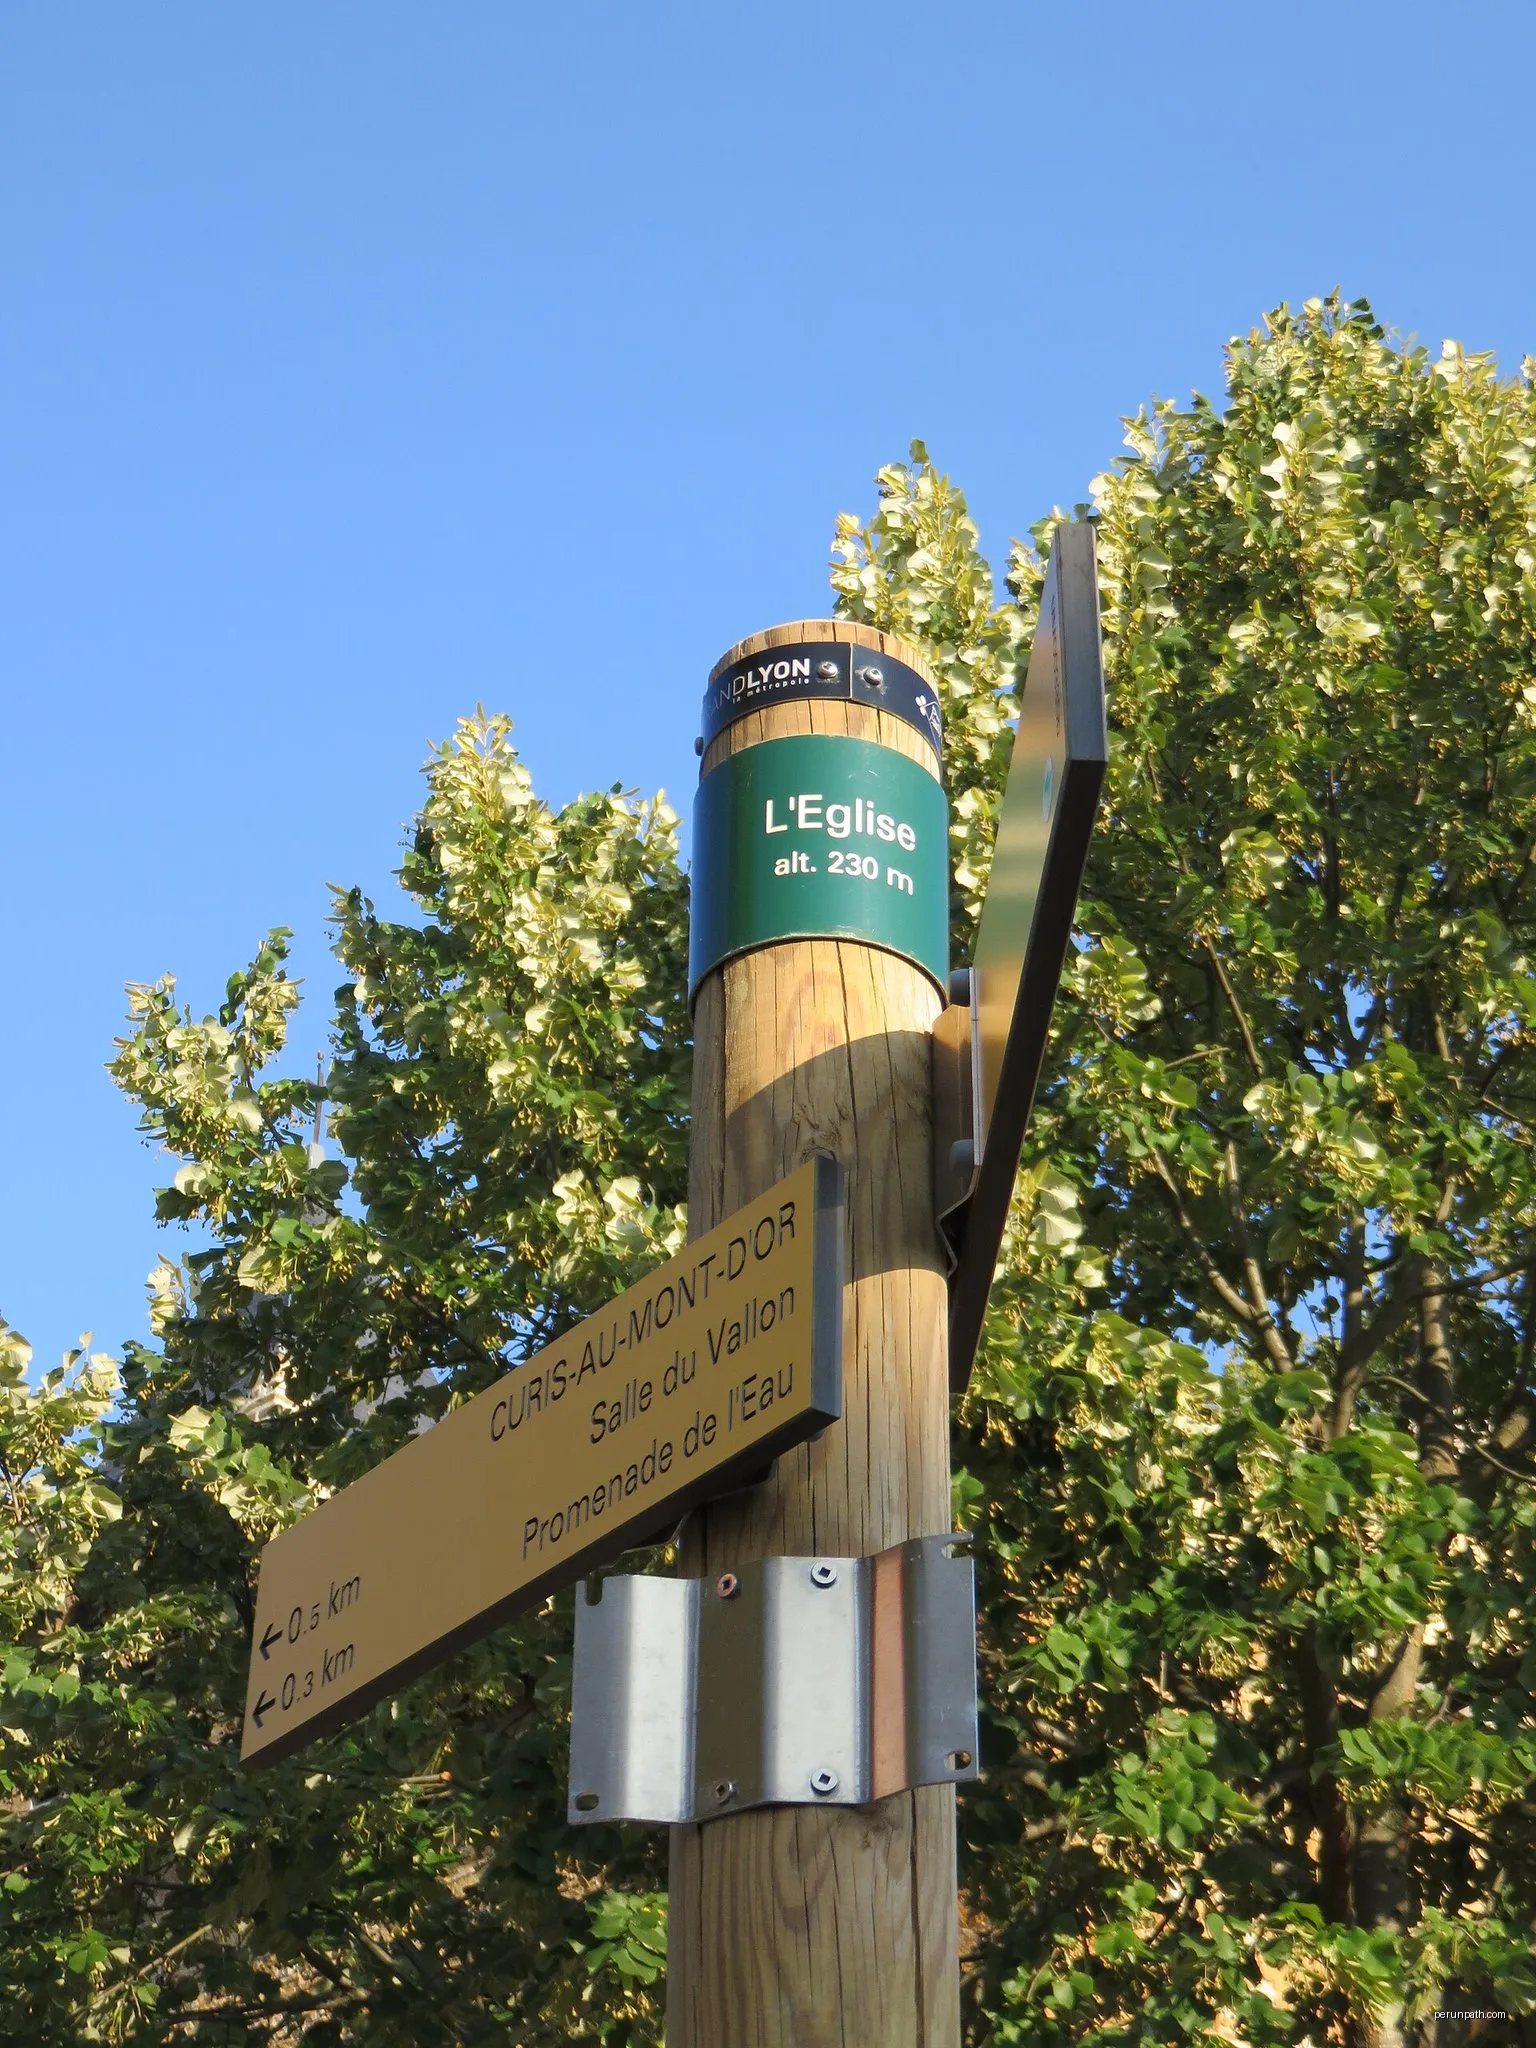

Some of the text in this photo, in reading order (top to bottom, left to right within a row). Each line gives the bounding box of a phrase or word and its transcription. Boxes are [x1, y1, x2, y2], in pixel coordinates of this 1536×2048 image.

[766, 794, 916, 852] L'Eglise
[774, 851, 914, 896] alt. 230 m
[490, 1200, 796, 1443] CURIS-AU-MONT-D'OR
[590, 1286, 795, 1445] Salle du Vallon
[522, 1363, 793, 1562] Promenade de l'Eau
[288, 1576, 360, 1645] 0.5 km
[281, 1643, 355, 1711] 0.3 km
